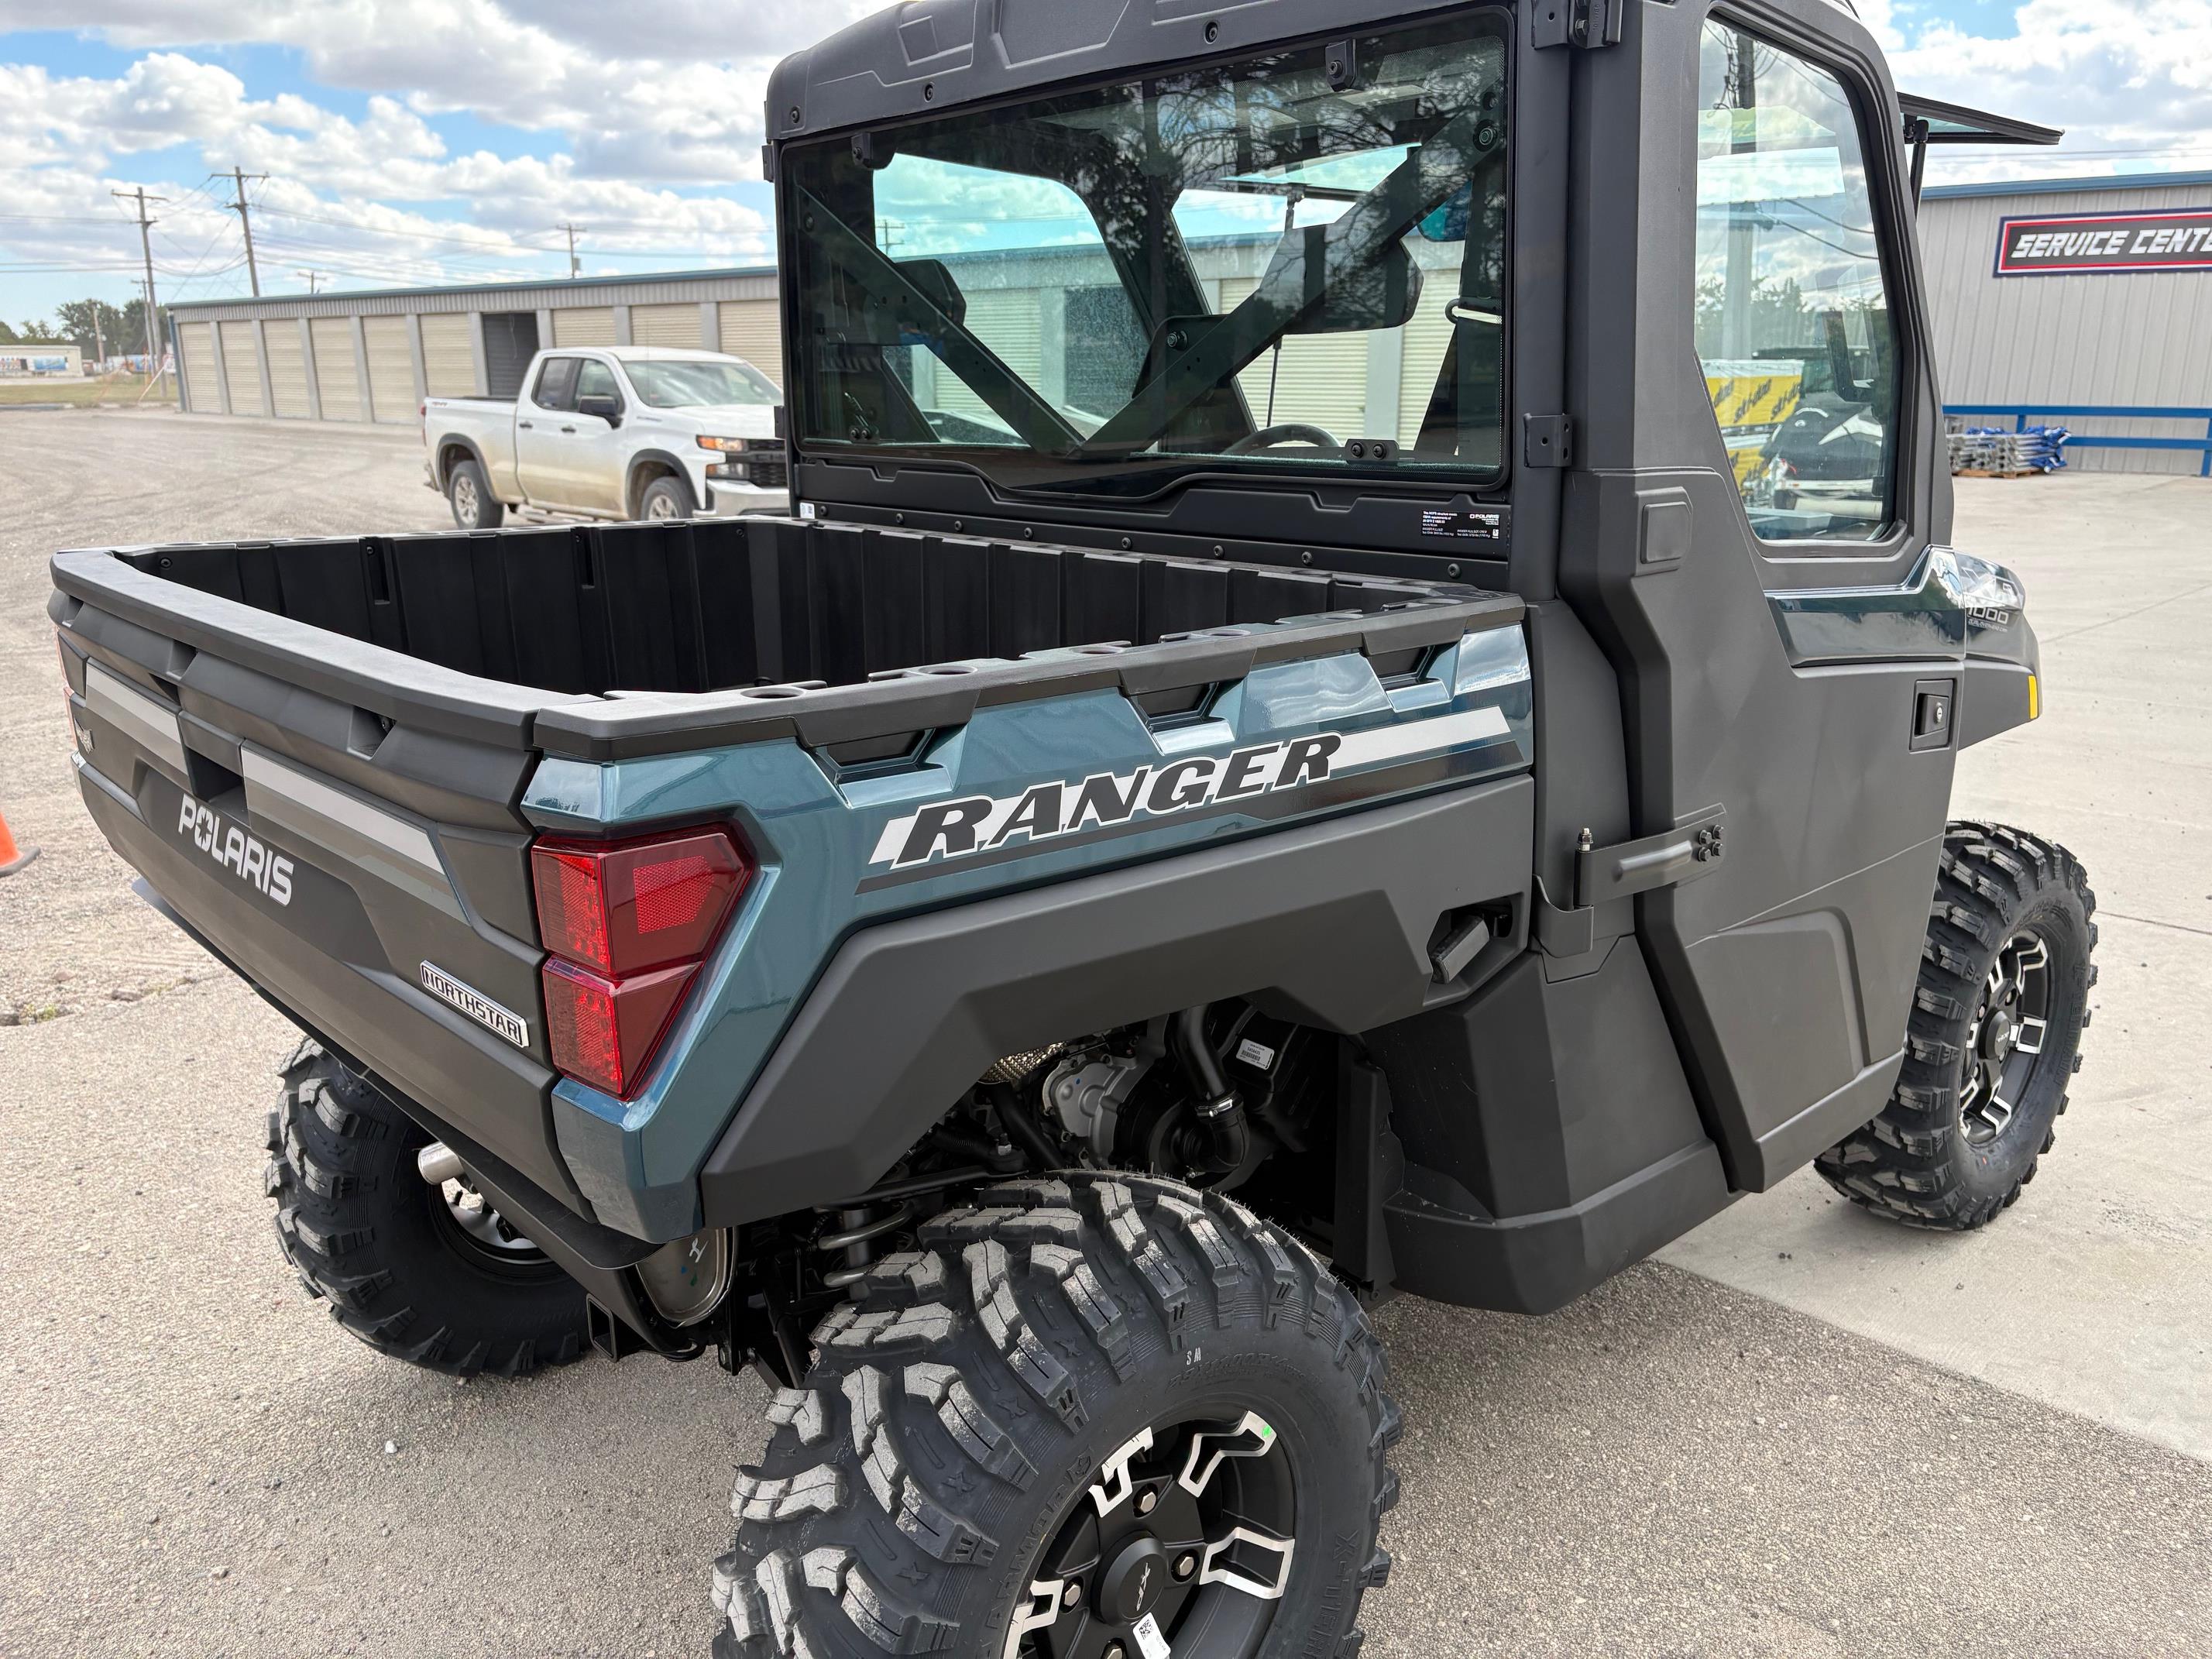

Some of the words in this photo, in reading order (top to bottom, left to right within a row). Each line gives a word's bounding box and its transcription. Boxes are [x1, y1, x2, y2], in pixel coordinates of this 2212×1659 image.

[2011, 231, 2130, 259] SERVICE
[1967, 607, 2009, 625] 1000
[892, 731, 1343, 869] RANGER
[177, 792, 295, 907] POLARIS
[424, 969, 519, 1042] NORTHSTAR
